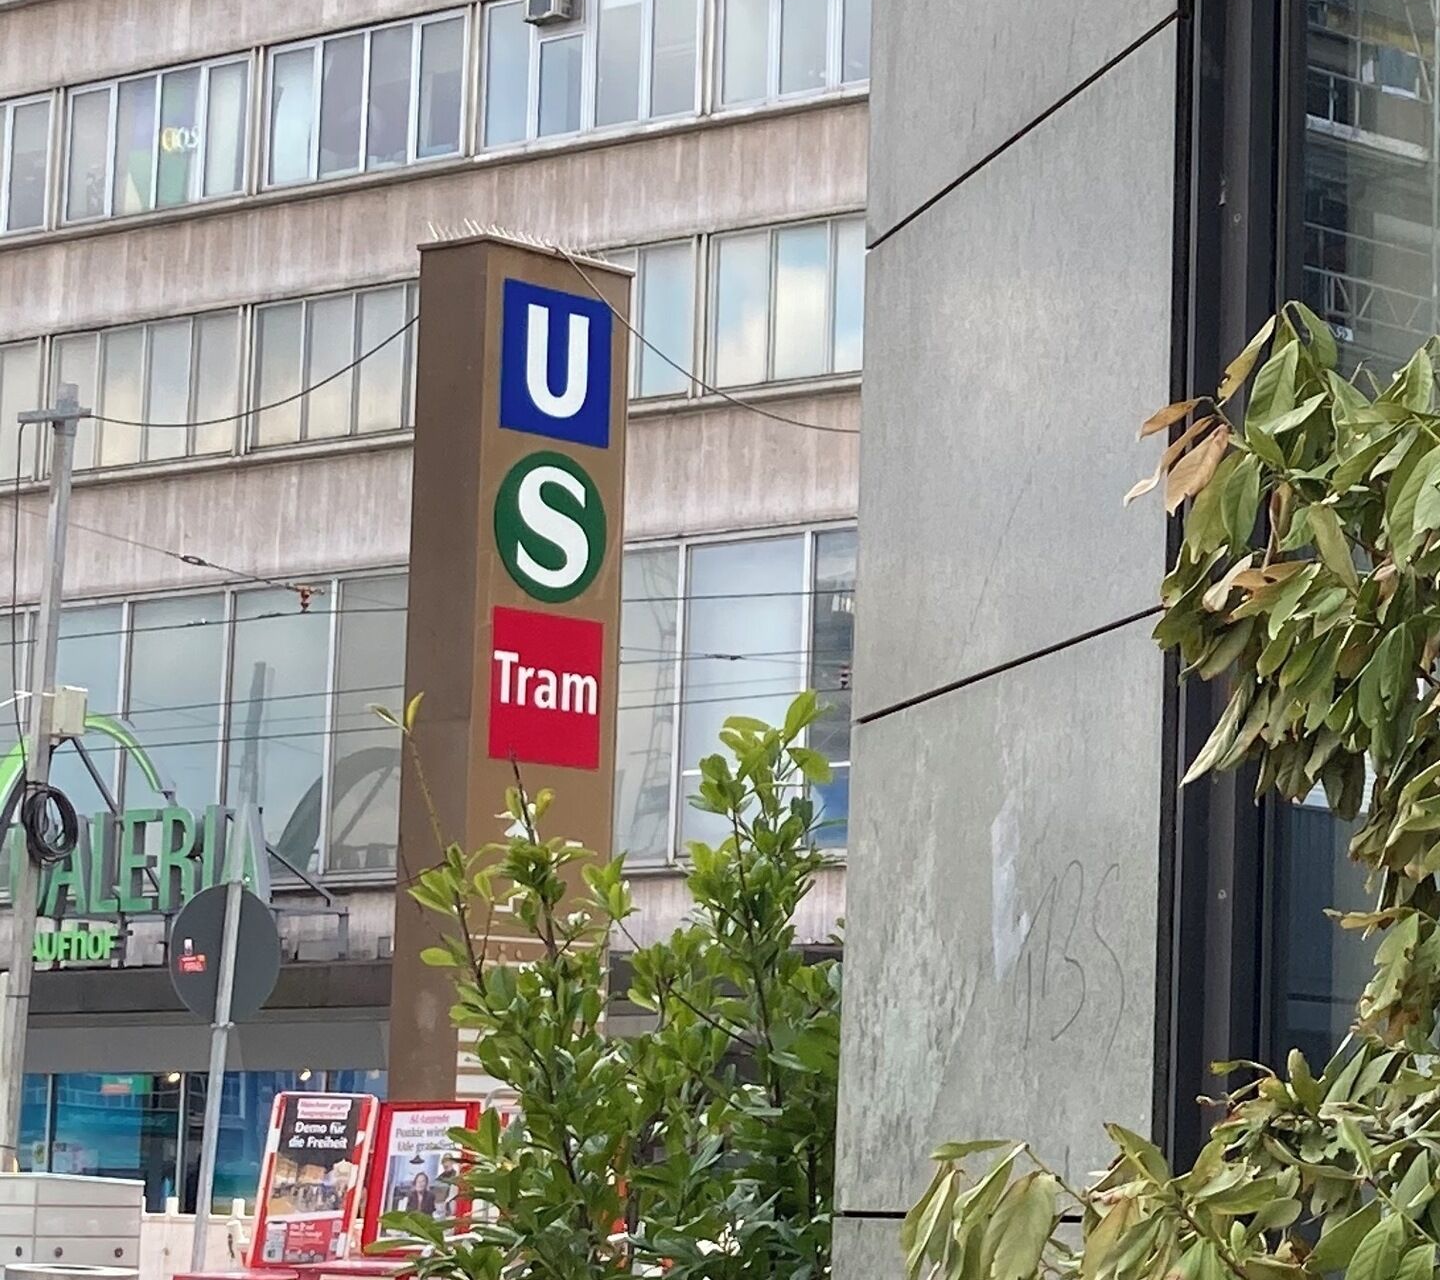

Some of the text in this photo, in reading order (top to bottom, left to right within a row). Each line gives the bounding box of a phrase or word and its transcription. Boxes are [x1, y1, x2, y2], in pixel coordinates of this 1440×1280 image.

[525, 303, 590, 419] U
[516, 465, 589, 589] S
[493, 649, 599, 716] Tram
[288, 1135, 348, 1149] die Freiheit
[295, 1121, 347, 1135] Demo für
